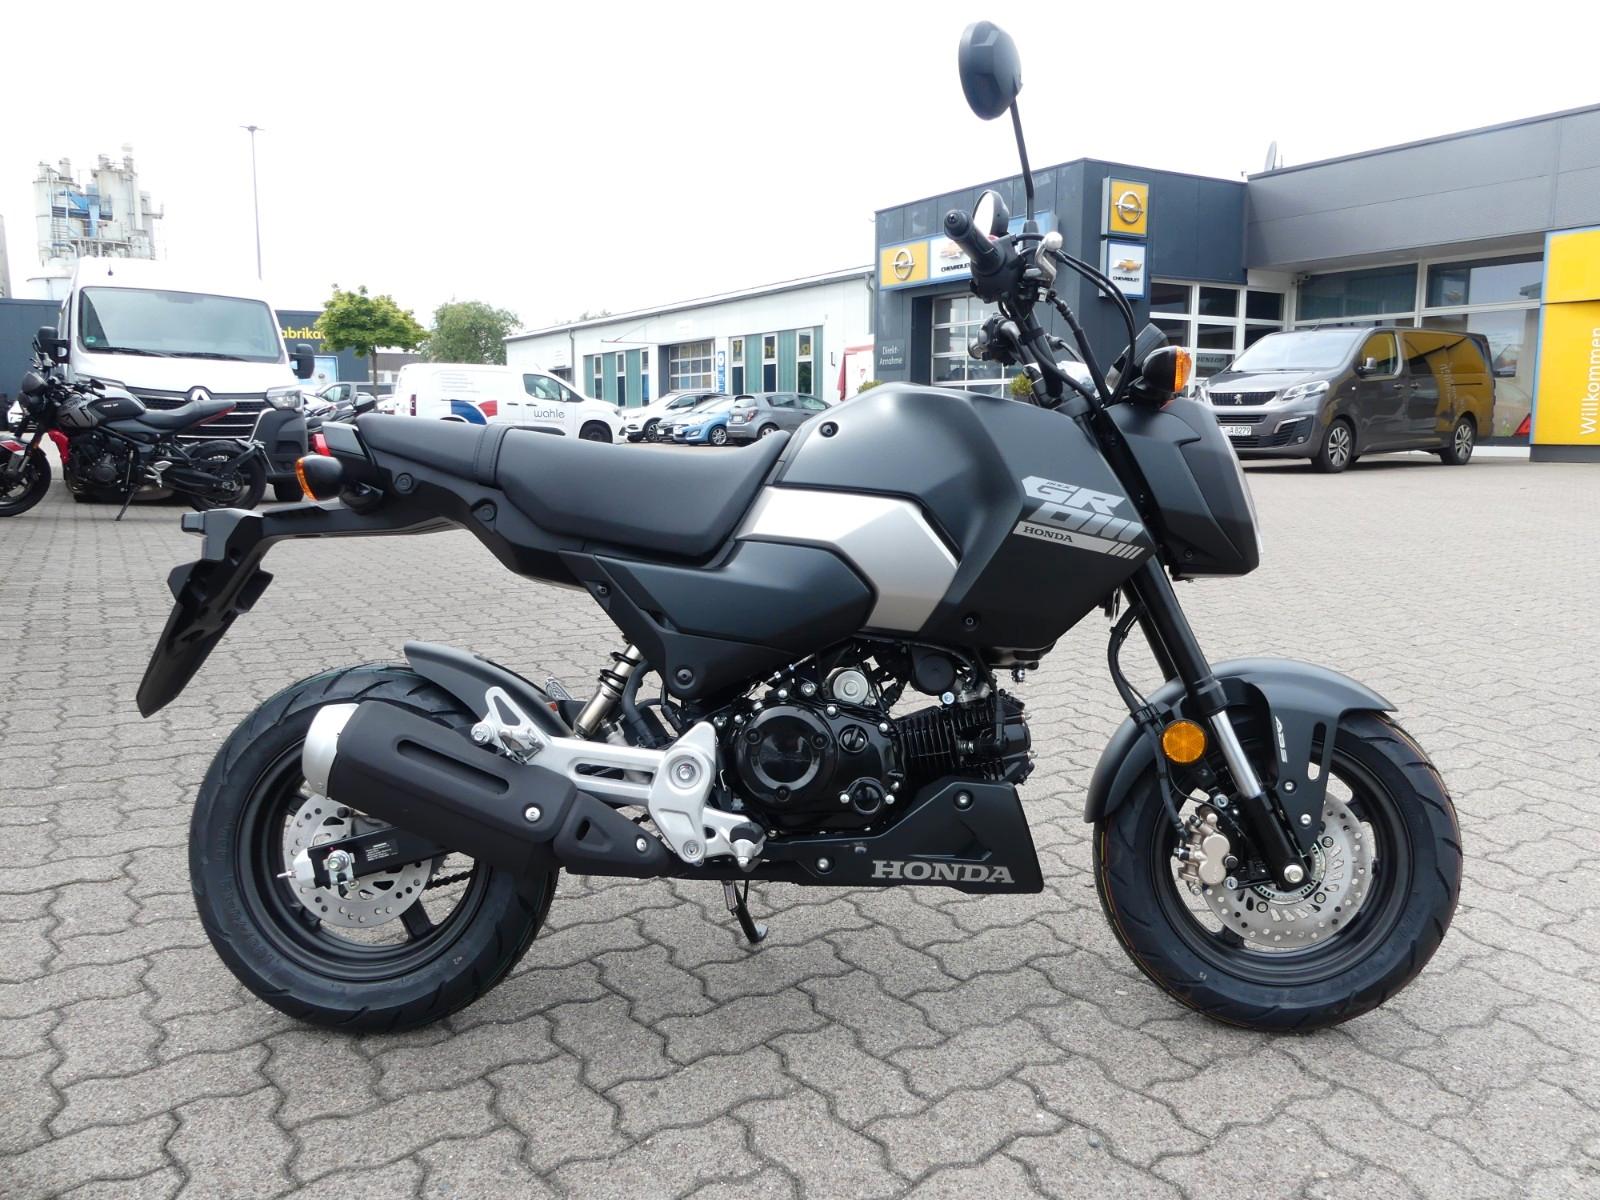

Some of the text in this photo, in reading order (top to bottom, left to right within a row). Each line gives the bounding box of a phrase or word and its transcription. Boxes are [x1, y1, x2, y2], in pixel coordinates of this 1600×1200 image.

[1579, 327, 1600, 434] Willkommen
[534, 408, 564, 419] wahle
[1023, 526, 1073, 543] HONDA
[1275, 715, 1288, 763] ABS
[871, 859, 1016, 884] HONDA
